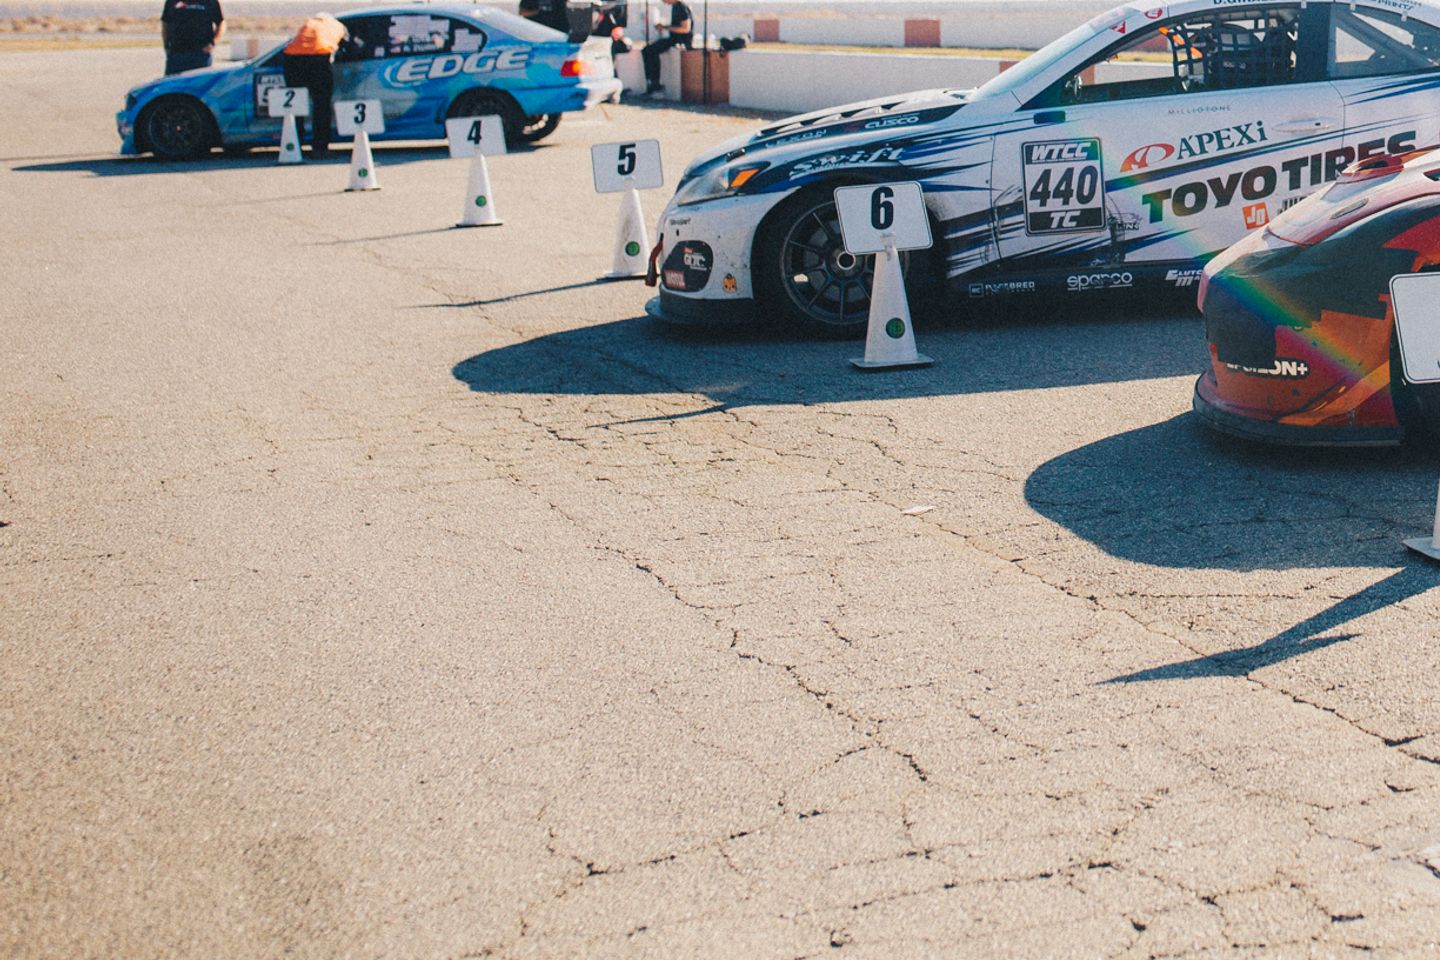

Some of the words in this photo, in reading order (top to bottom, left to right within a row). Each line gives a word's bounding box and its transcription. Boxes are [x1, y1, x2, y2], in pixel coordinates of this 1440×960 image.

[396, 47, 531, 82] EDGE
[283, 90, 296, 108] 2
[354, 103, 366, 124] 3
[467, 120, 482, 145] 4
[617, 143, 636, 175] 5
[1031, 142, 1092, 161] WTCC
[1029, 165, 1099, 207] 440
[1142, 163, 1277, 224] TOYO
[871, 186, 894, 230] 6
[1050, 210, 1080, 229] TC
[1067, 272, 1133, 291] sparco
